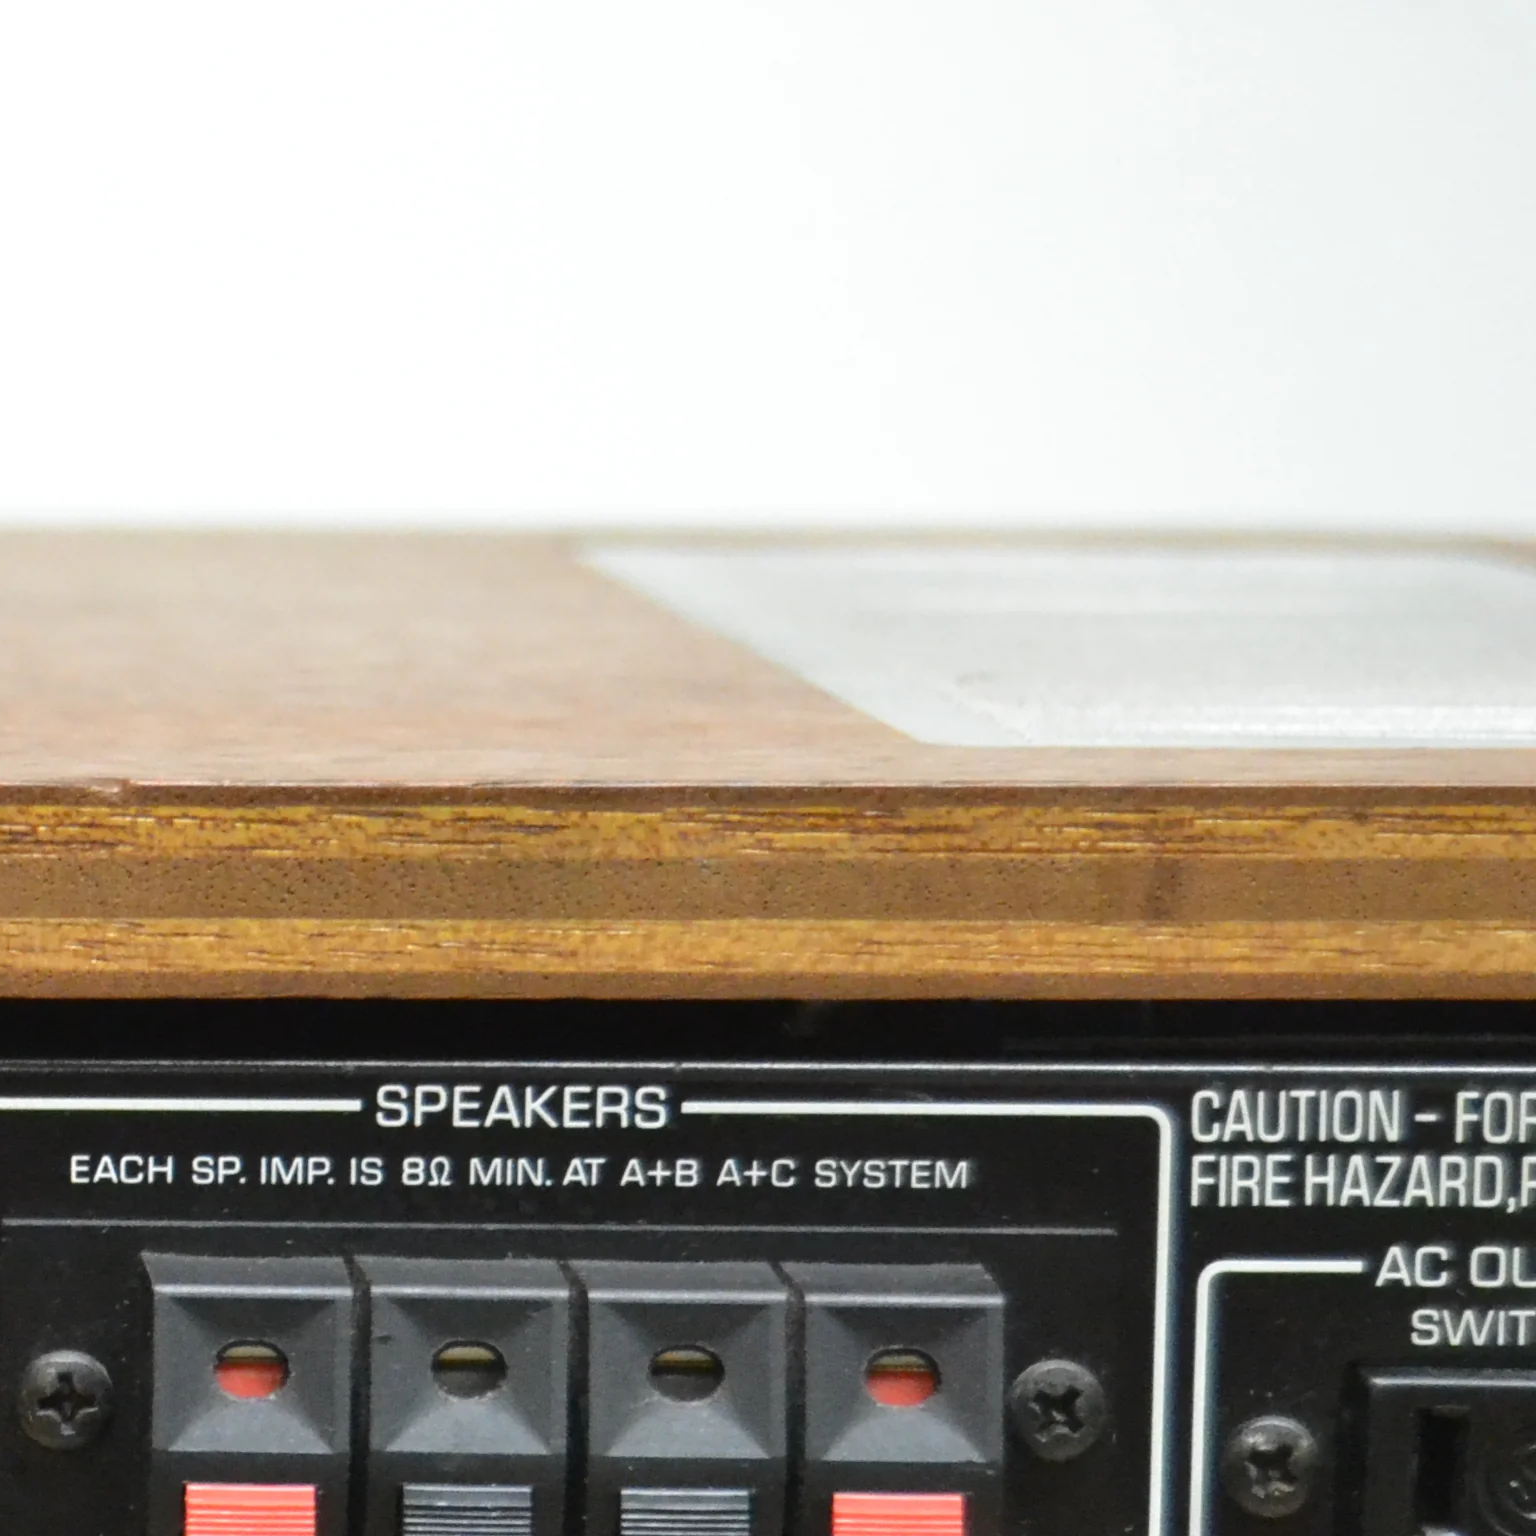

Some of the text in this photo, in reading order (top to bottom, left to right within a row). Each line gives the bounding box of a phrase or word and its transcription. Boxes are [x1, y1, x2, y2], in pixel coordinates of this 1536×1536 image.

[376, 1085, 669, 1130] SPEAKERS
[1192, 1090, 1403, 1144] CAUTION
[71, 1155, 175, 1185] EACH
[192, 1156, 247, 1186] SP.
[261, 1157, 336, 1186] IMP.
[351, 1157, 385, 1187] IS
[470, 1158, 554, 1188] MIN.
[563, 1158, 608, 1188] AT
[621, 1159, 700, 1189] A+B
[717, 1159, 797, 1189] A+C
[815, 1159, 971, 1190] SYSTEM
[1191, 1154, 1294, 1208] FIRE
[1376, 1246, 1452, 1289] AC
[1411, 1309, 1536, 1347] SWIT
